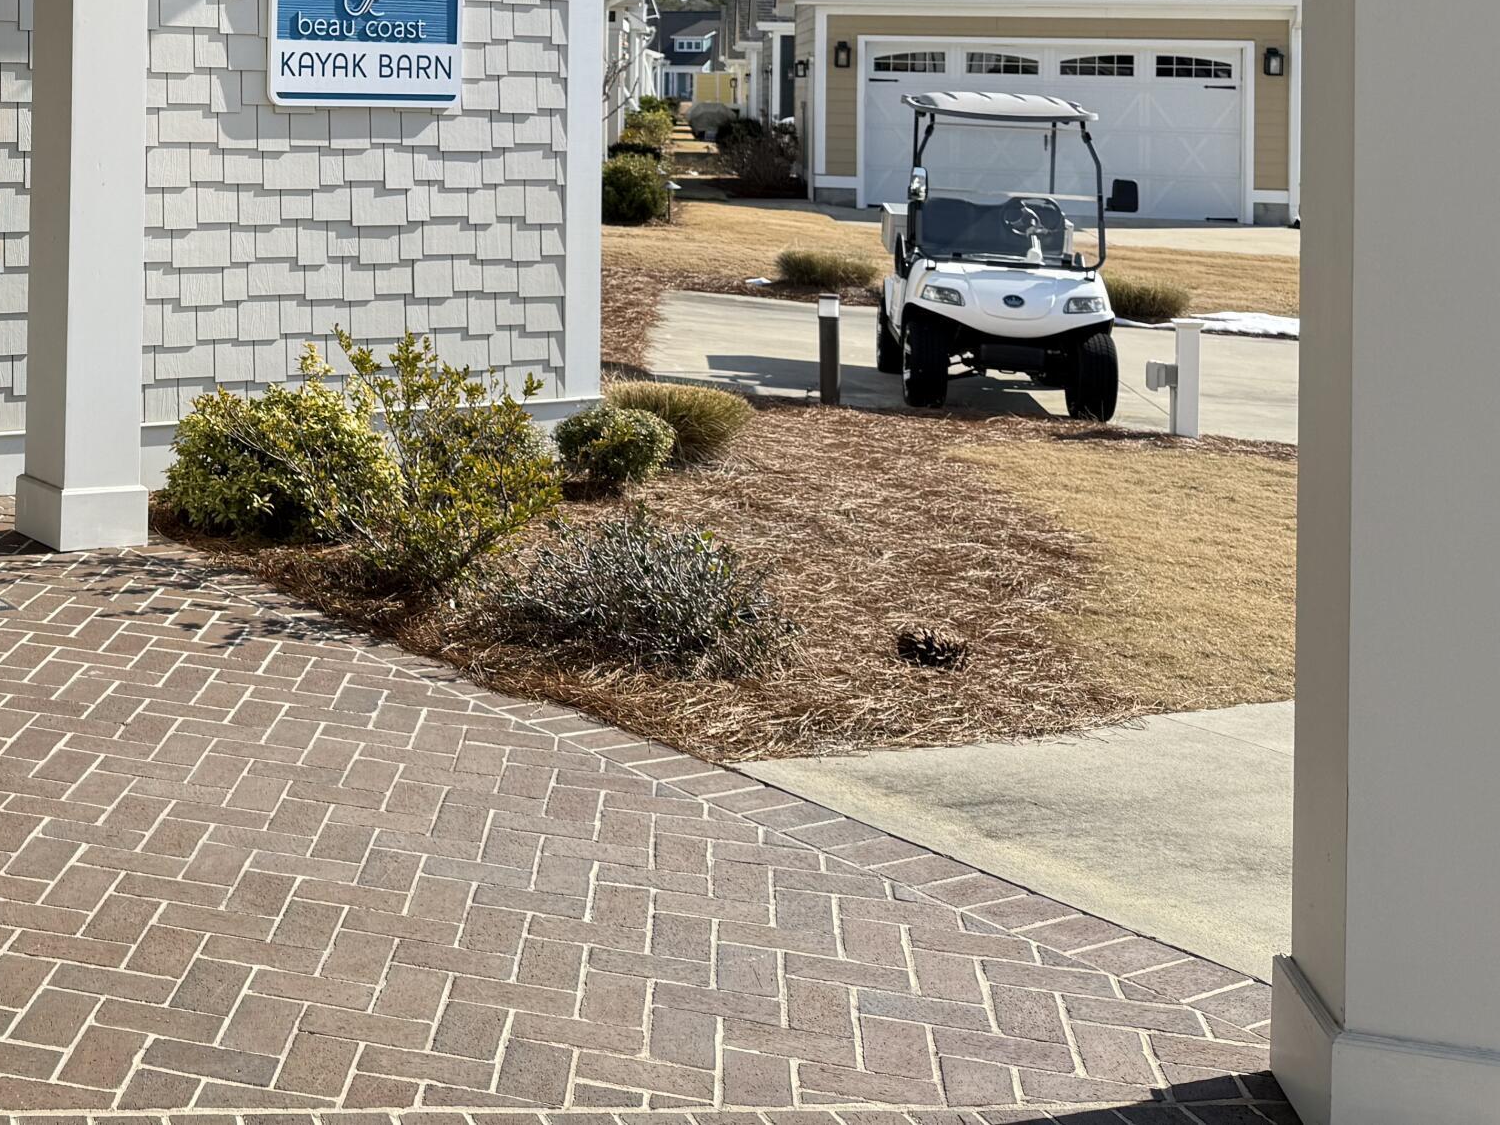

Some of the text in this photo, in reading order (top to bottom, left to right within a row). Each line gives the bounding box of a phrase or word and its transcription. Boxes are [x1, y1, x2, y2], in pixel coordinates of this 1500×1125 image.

[298, 11, 427, 39] beau coast
[281, 51, 452, 80] KAYAK BARN
